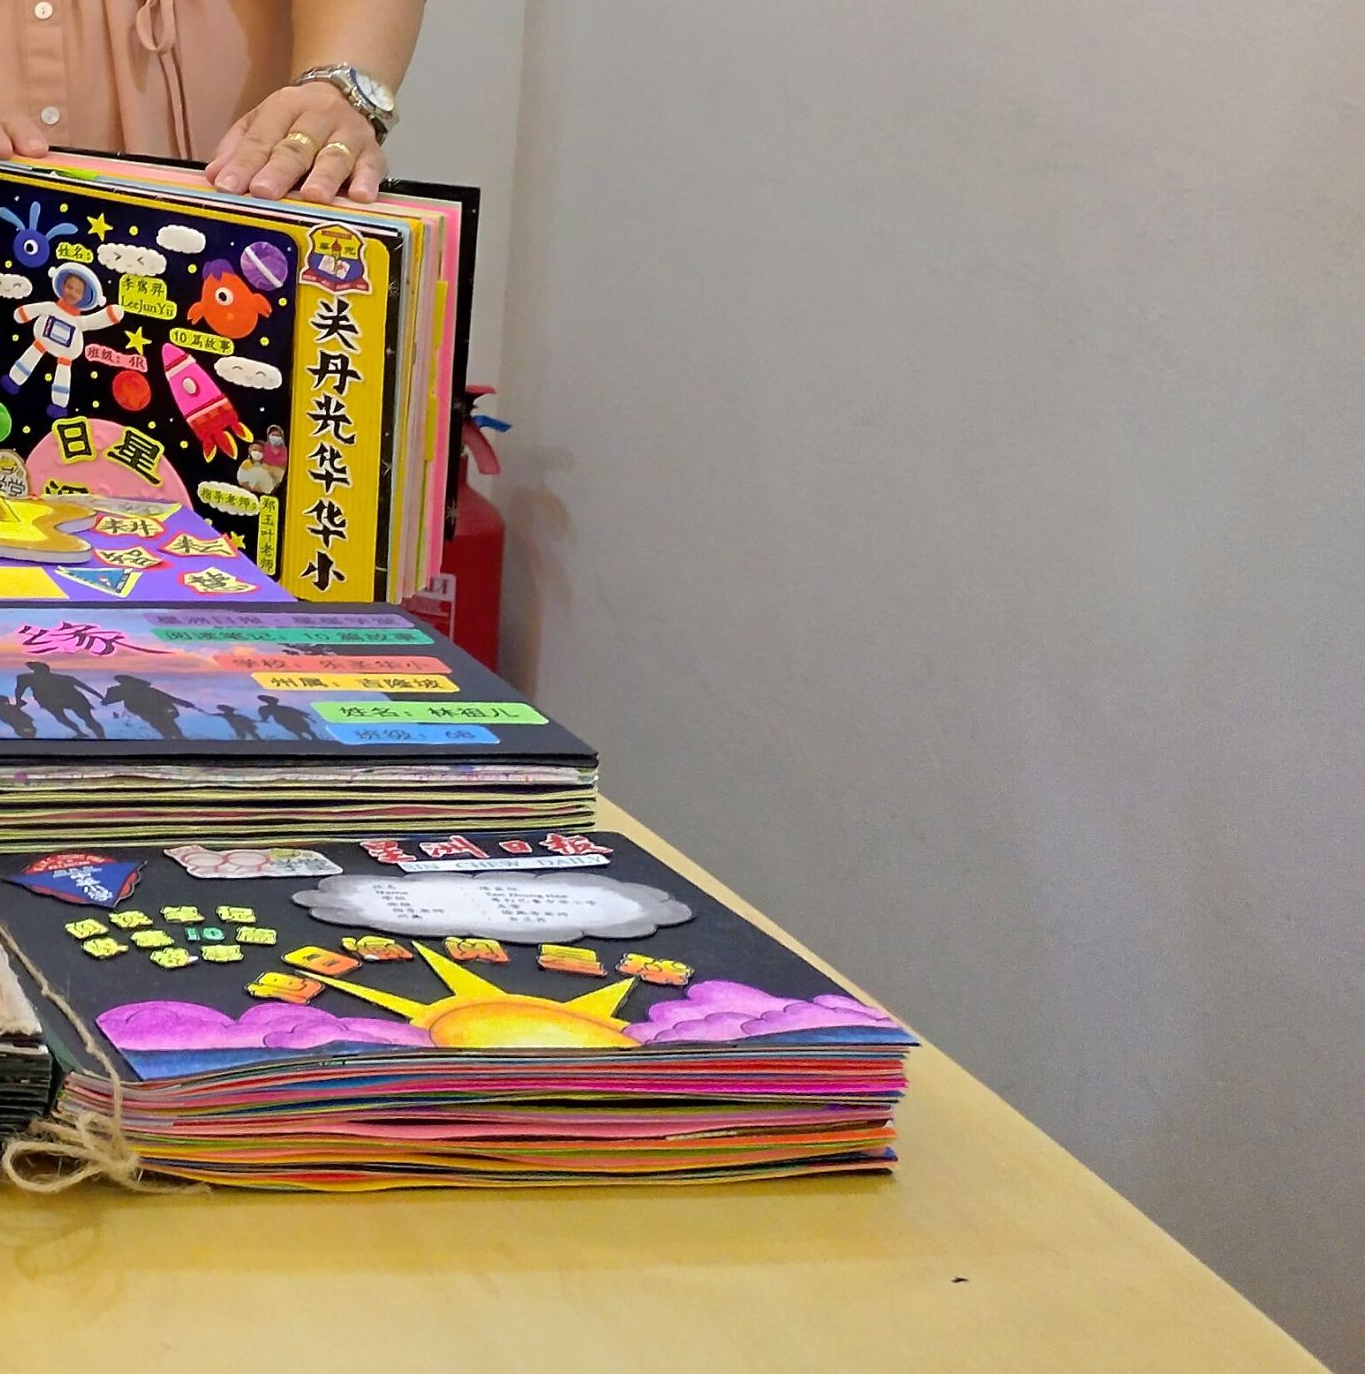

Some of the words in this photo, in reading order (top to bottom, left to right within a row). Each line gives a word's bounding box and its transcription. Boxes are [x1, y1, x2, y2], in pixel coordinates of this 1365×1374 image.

[57, 421, 93, 459] 日
[107, 429, 161, 485] 星
[299, 297, 365, 592] 关丹光华华小
[538, 856, 603, 866] DAILY
